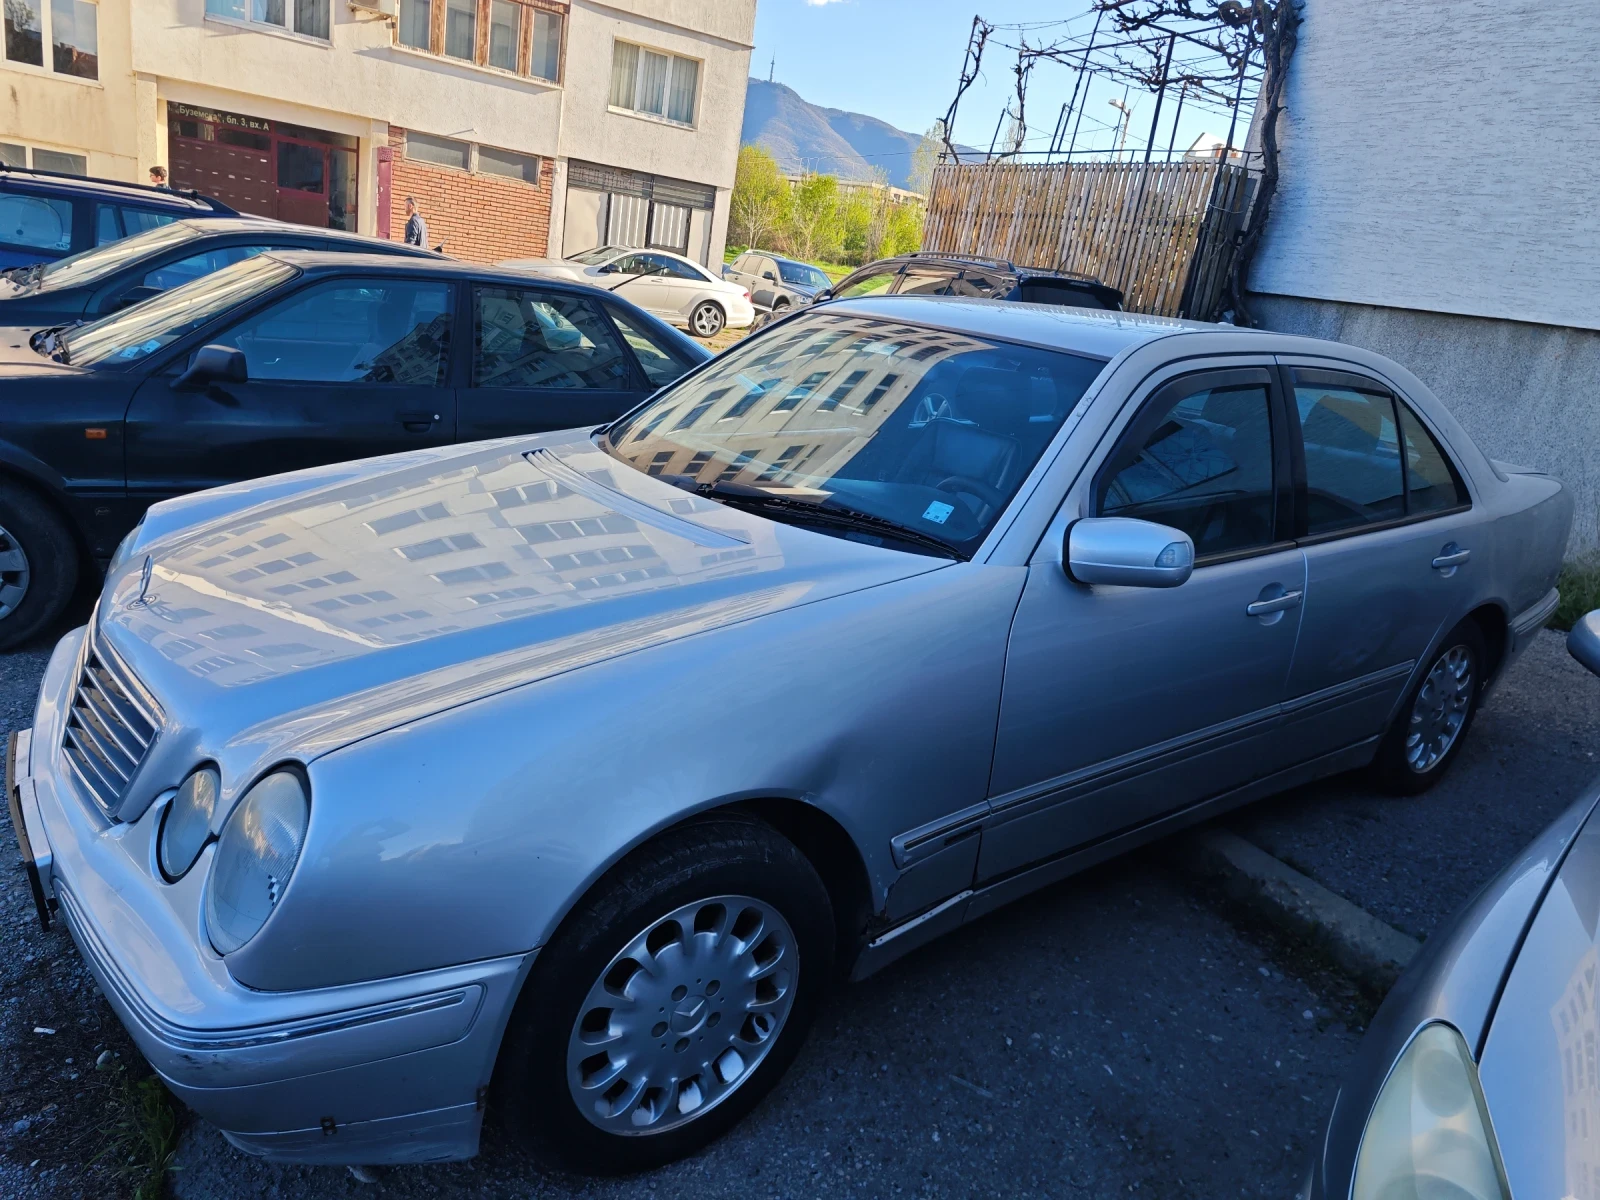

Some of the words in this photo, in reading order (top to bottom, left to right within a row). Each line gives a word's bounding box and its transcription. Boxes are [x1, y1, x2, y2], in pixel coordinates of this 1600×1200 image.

[226, 115, 239, 125] бл.
[240, 117, 248, 128] 3,
[249, 121, 261, 129] вх.
